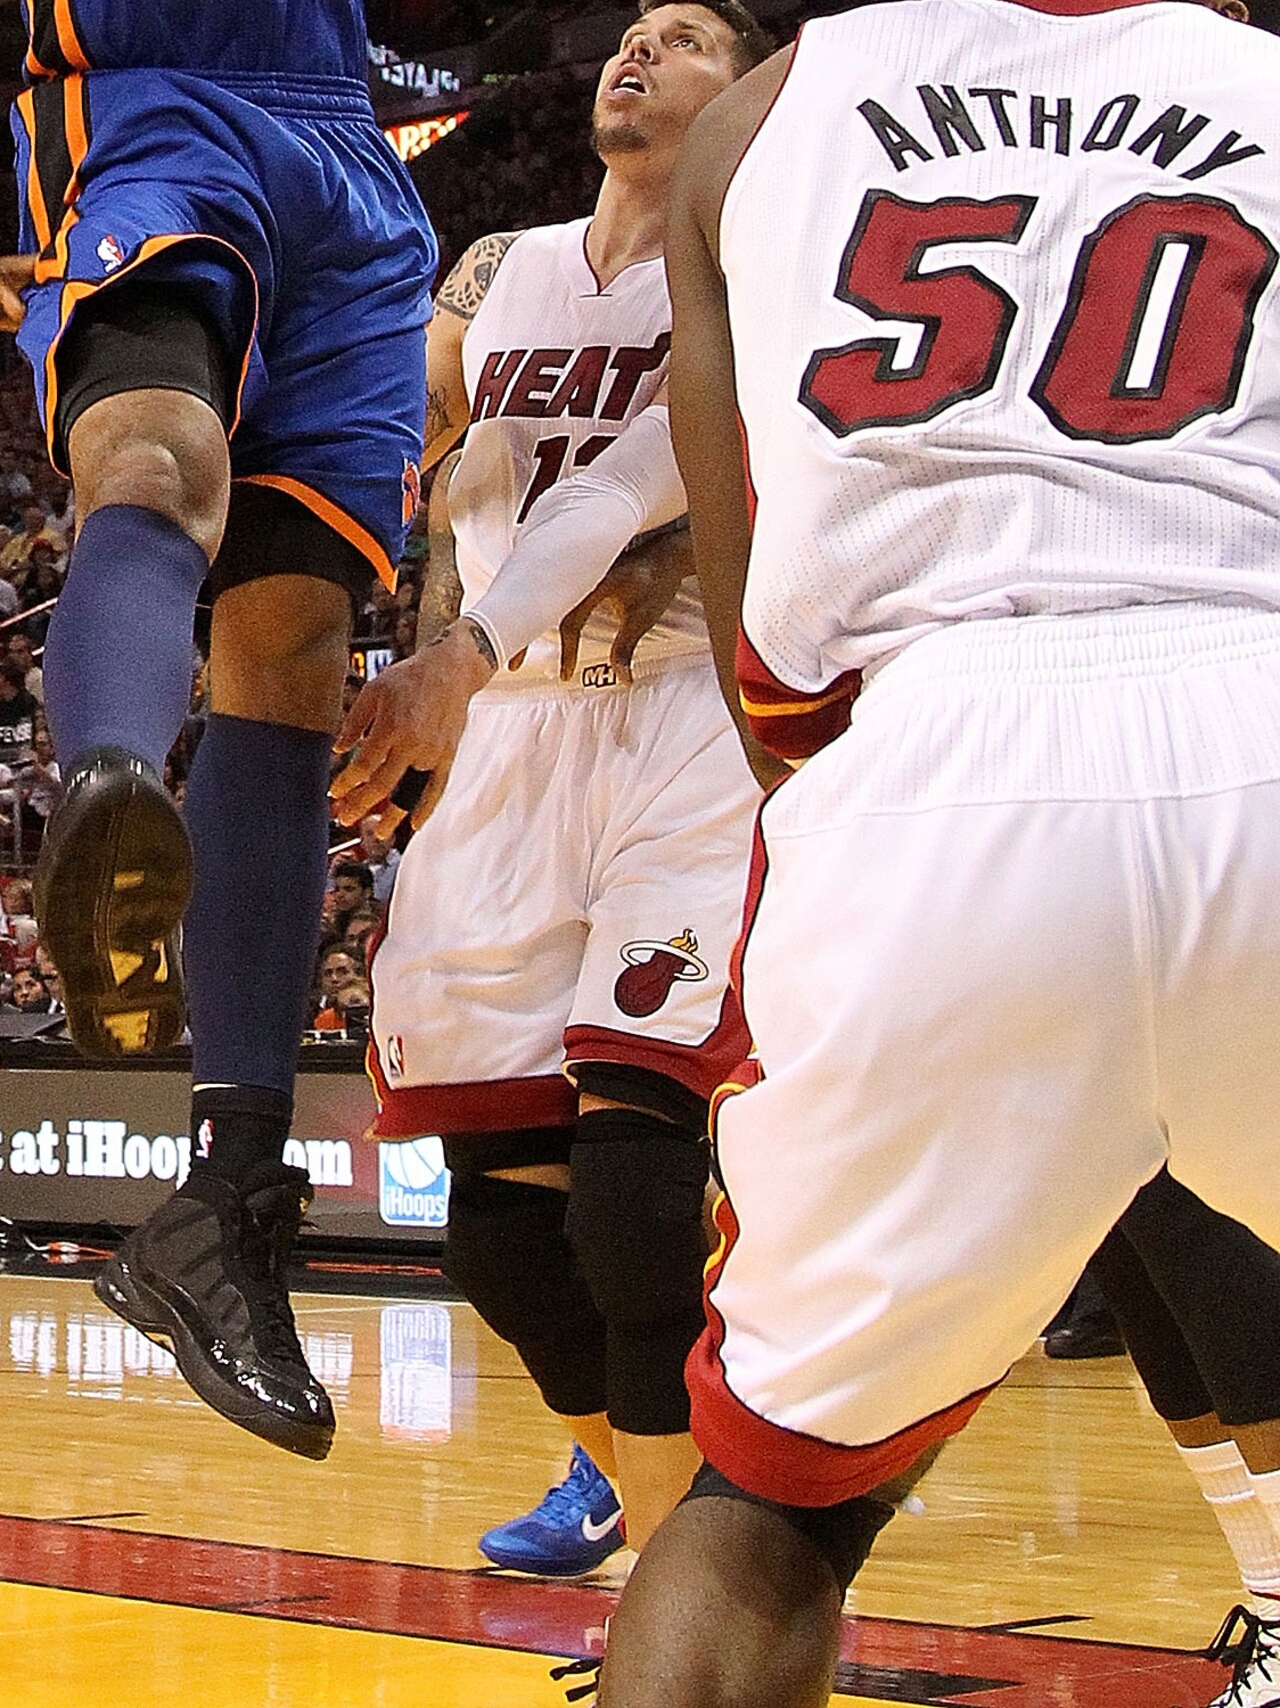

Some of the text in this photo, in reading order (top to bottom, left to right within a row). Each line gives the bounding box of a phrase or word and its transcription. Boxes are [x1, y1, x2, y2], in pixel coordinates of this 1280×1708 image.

[856, 83, 1266, 180] ANTHONY
[797, 188, 1280, 445] 50
[470, 330, 672, 423] HEAT
[9, 1118, 61, 1175] at
[387, 1186, 447, 1223] iHoops
